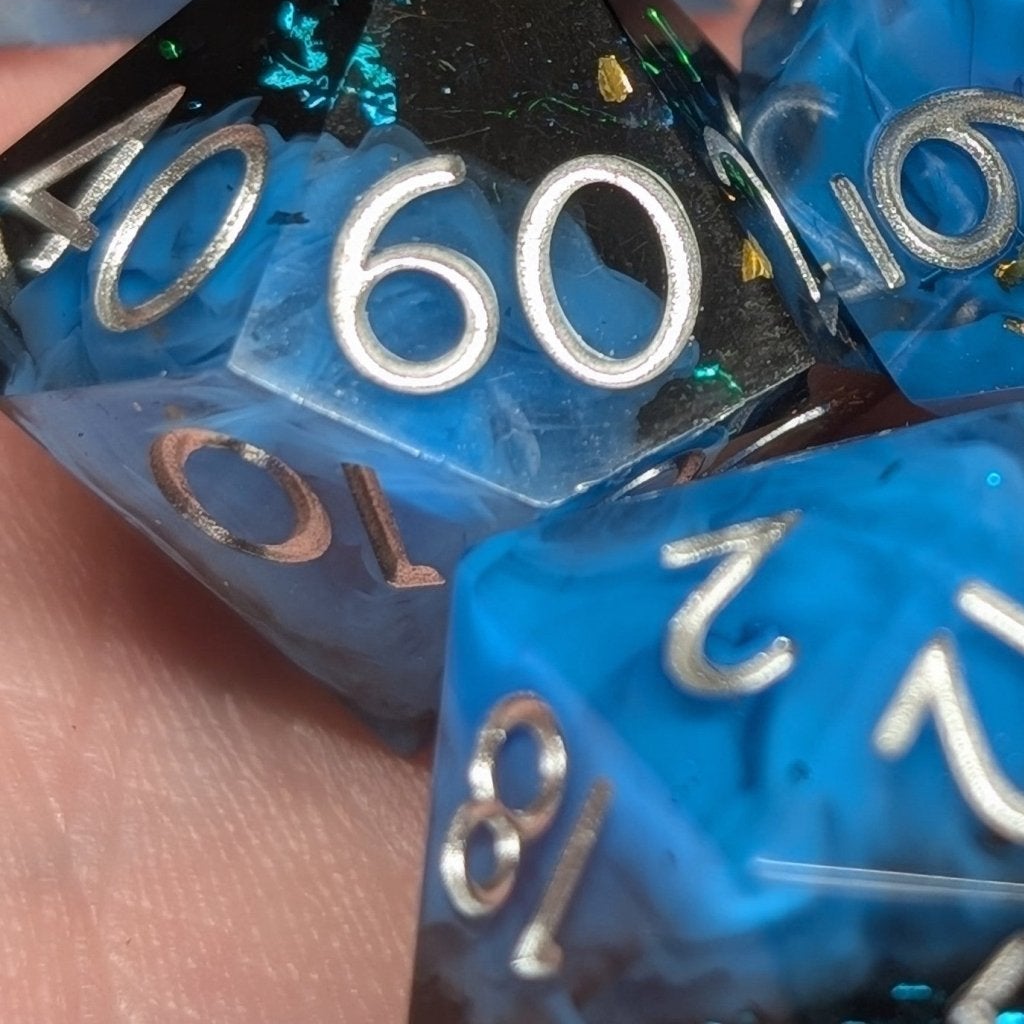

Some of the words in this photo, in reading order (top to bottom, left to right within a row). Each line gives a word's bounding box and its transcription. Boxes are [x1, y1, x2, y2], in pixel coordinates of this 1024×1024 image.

[8, 84, 268, 333] 40
[329, 153, 703, 395] 60
[149, 428, 446, 589] 10
[660, 509, 801, 698] 2
